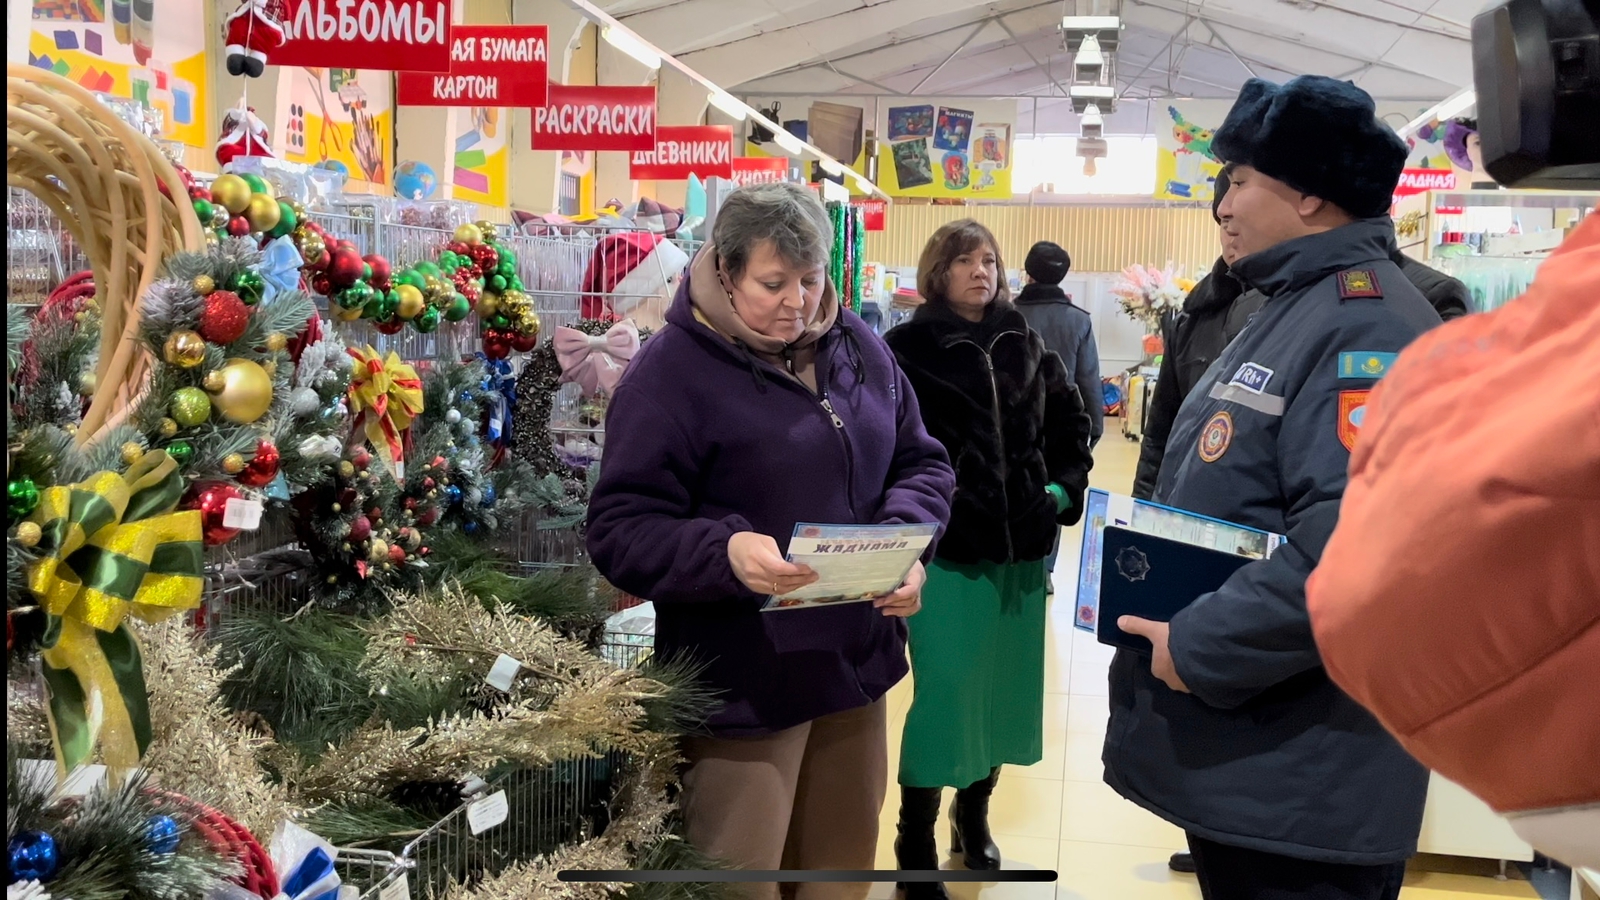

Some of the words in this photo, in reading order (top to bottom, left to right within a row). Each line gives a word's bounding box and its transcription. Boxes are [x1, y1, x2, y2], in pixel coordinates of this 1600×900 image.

[480, 37, 546, 62] БУМАГА
[433, 75, 498, 100] КАРТОН
[535, 103, 652, 136] РАСКРАСКИ
[632, 140, 730, 166] ДНЕВНИКИ
